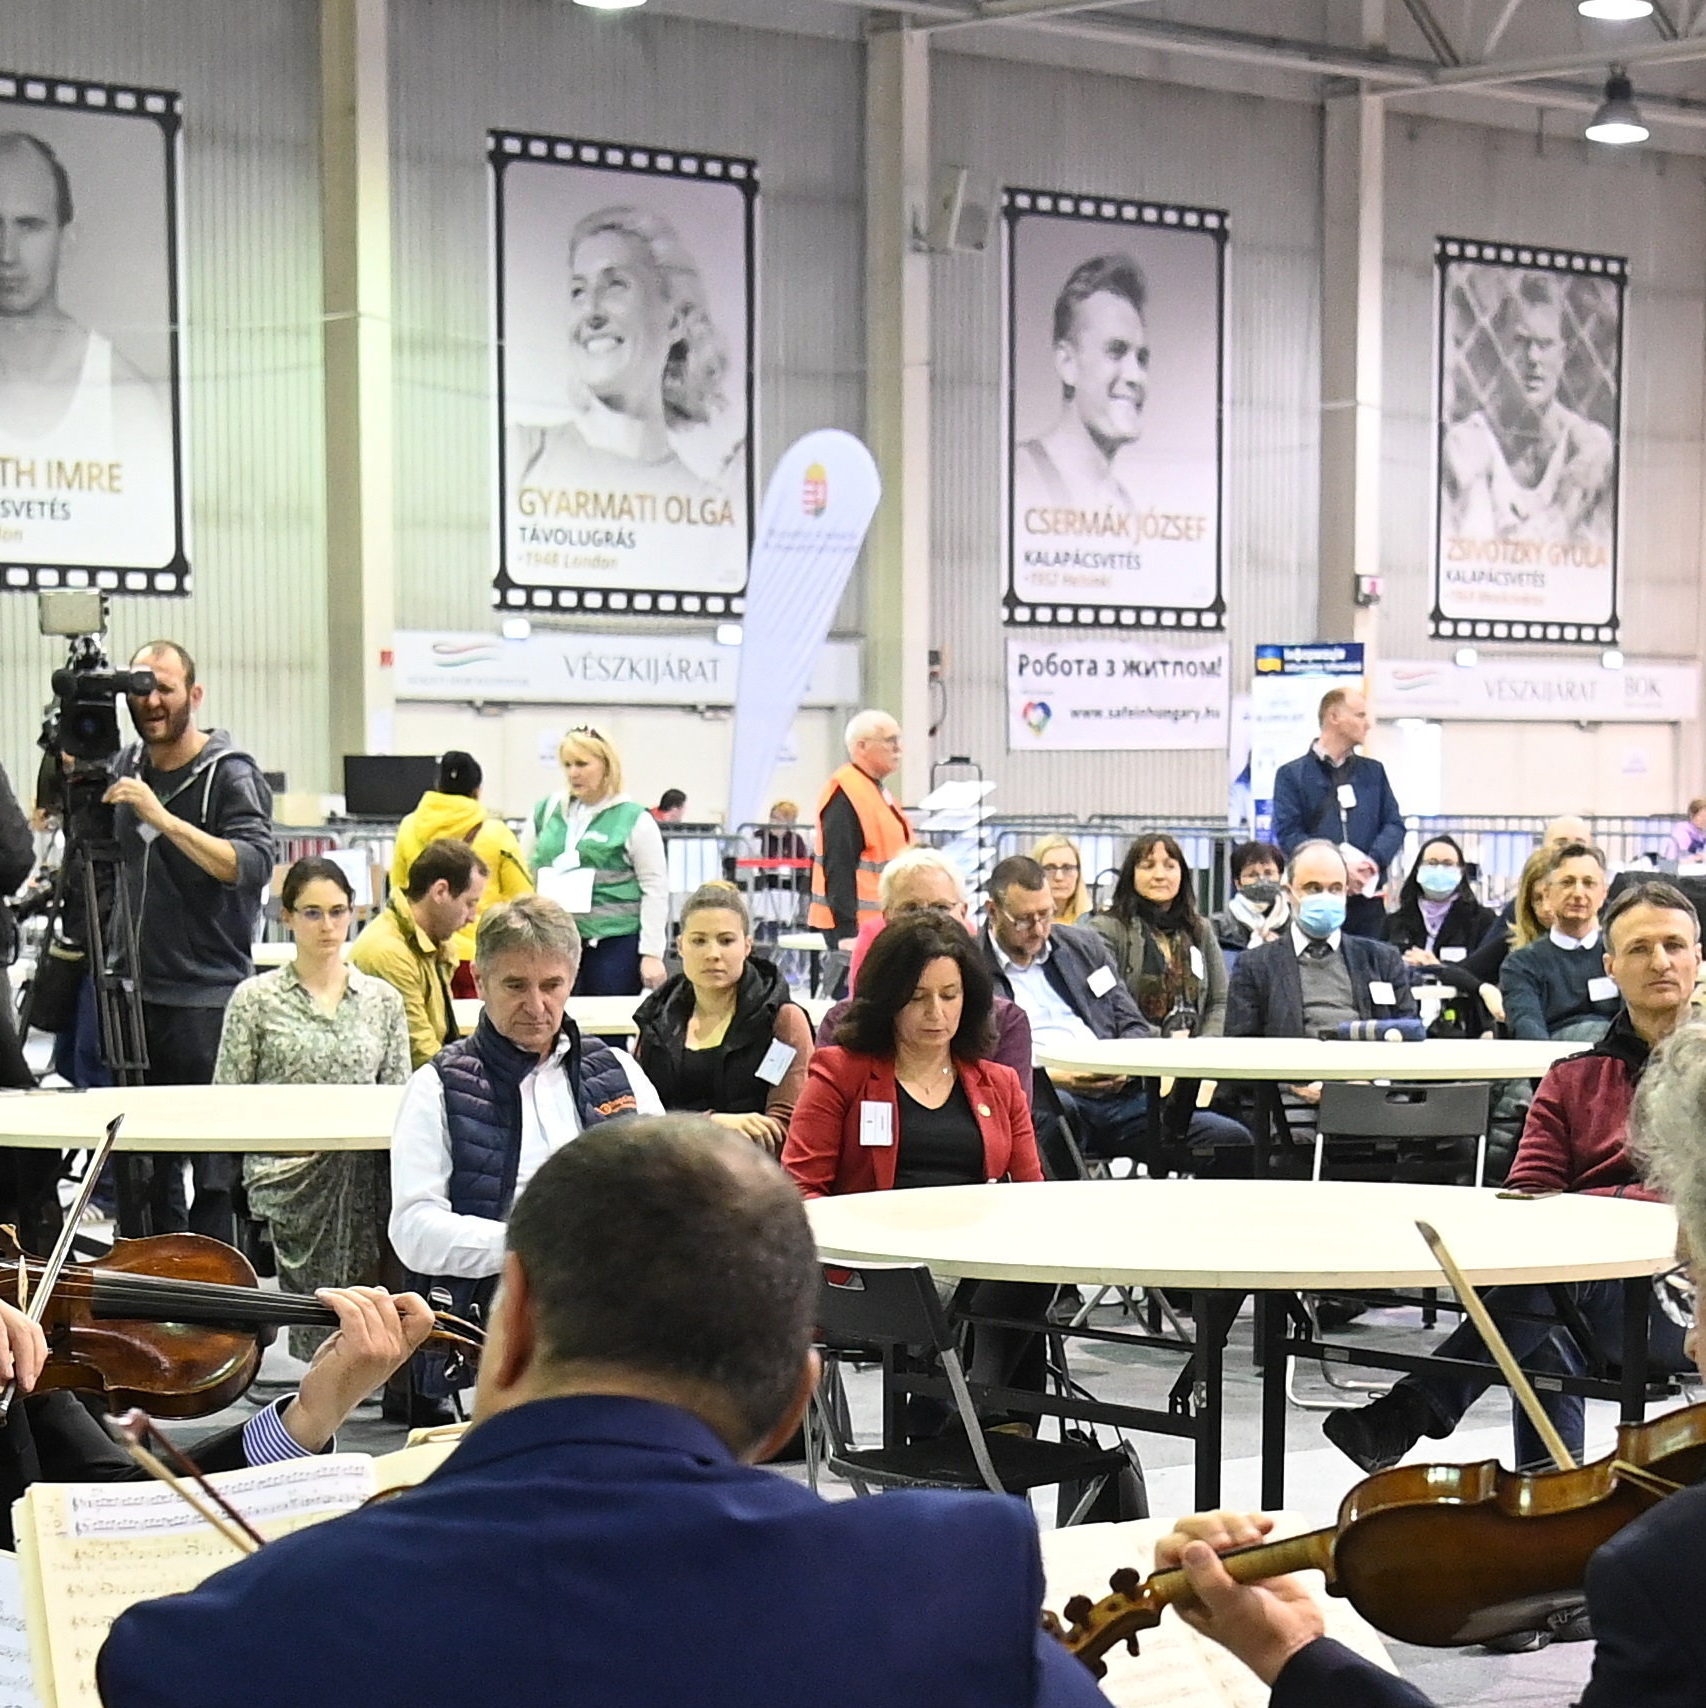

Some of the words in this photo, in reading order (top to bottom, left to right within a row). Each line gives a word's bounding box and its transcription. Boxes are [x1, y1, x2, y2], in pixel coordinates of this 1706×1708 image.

[46, 459, 123, 493] IMRE
[519, 488, 656, 522] GYARMATI
[664, 495, 735, 526] OLGA
[519, 522, 637, 549] TÁVOLUGRÁS
[1024, 504, 1128, 537] CSERMÁK
[1132, 505, 1207, 546] JÓZSEF
[1024, 548, 1142, 571] KALAPÁCSVETÉS
[562, 650, 722, 686] VÉSZKIJÁRAT
[1018, 652, 1098, 677] Робота
[1483, 677, 1598, 705] VÉSZKIJÁRAT
[1624, 675, 1662, 699] BOK
